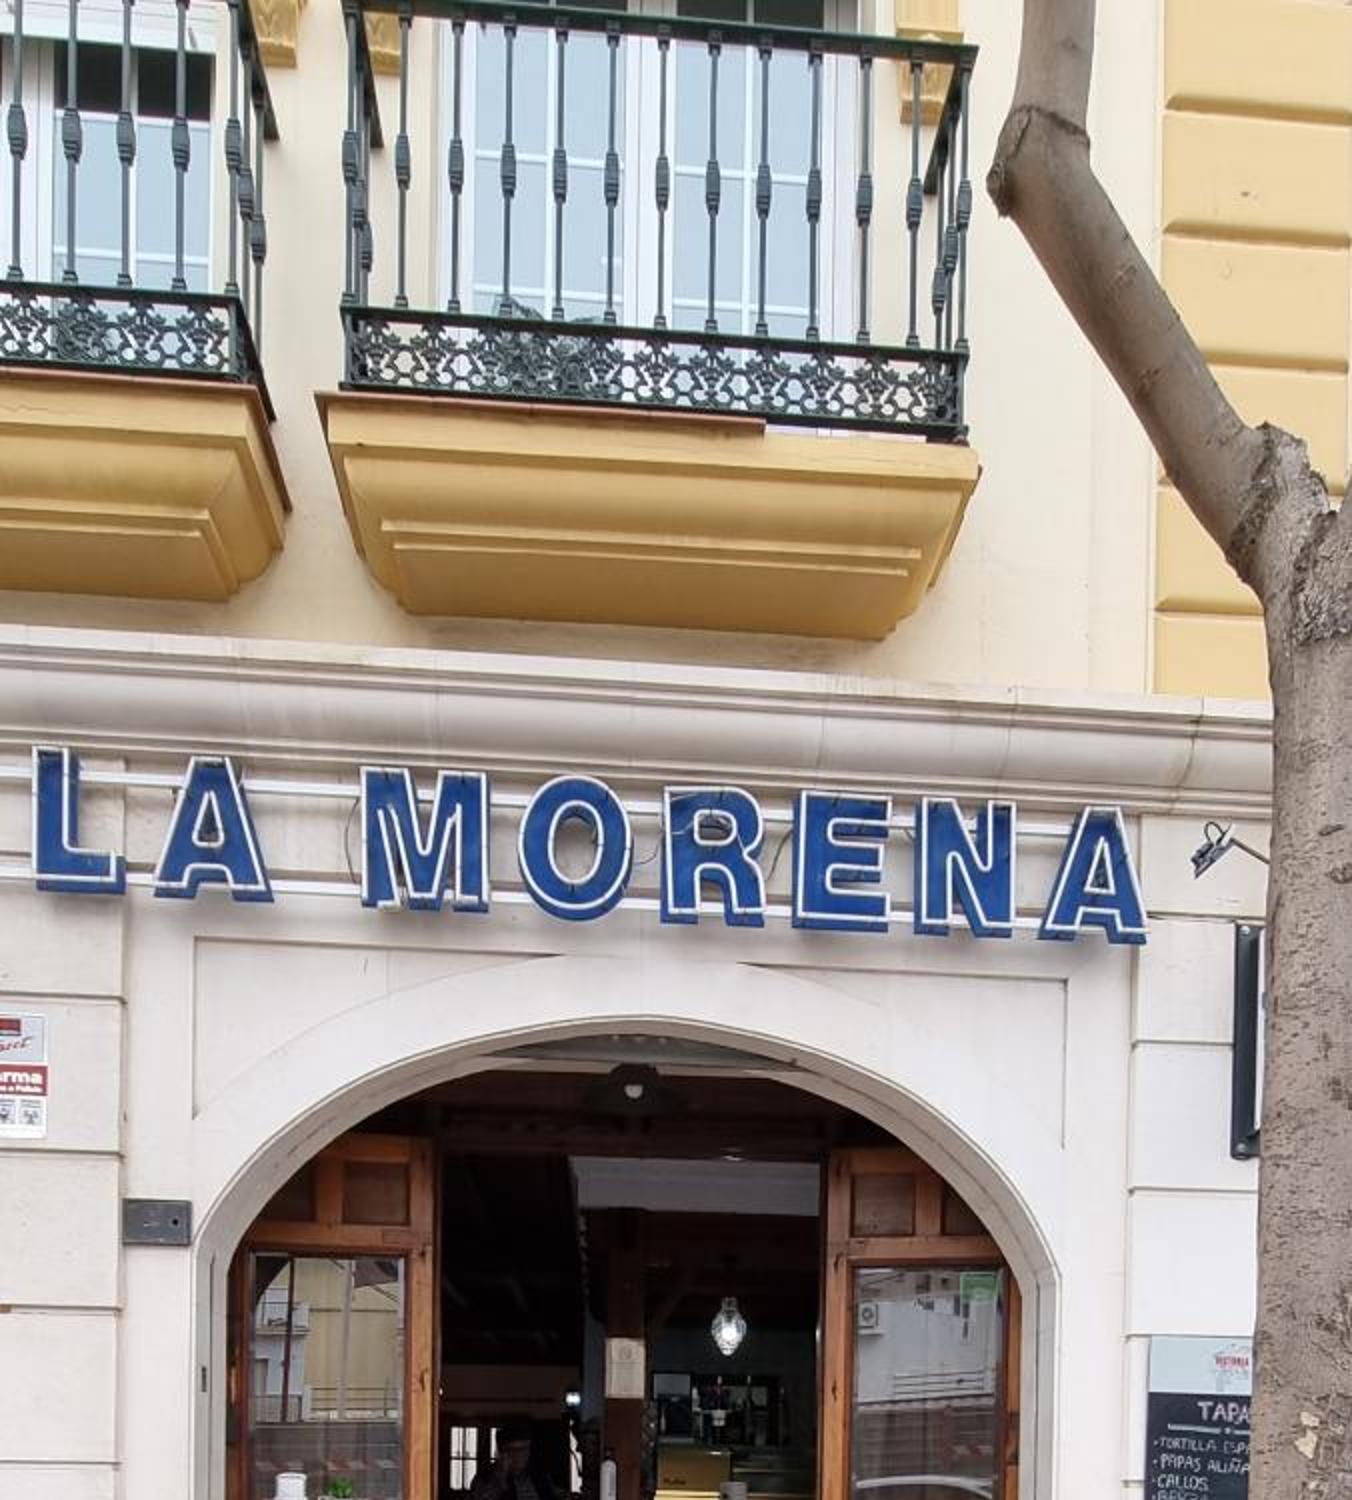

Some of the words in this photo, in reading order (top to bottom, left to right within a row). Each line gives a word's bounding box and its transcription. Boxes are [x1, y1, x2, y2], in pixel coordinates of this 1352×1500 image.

[31, 745, 274, 903] LA
[360, 765, 1148, 945] MORENA
[1160, 1437, 1217, 1452] TORTILLA
[1160, 1453, 1201, 1472] PAPAS
[1157, 1474, 1208, 1491] CALLOS
